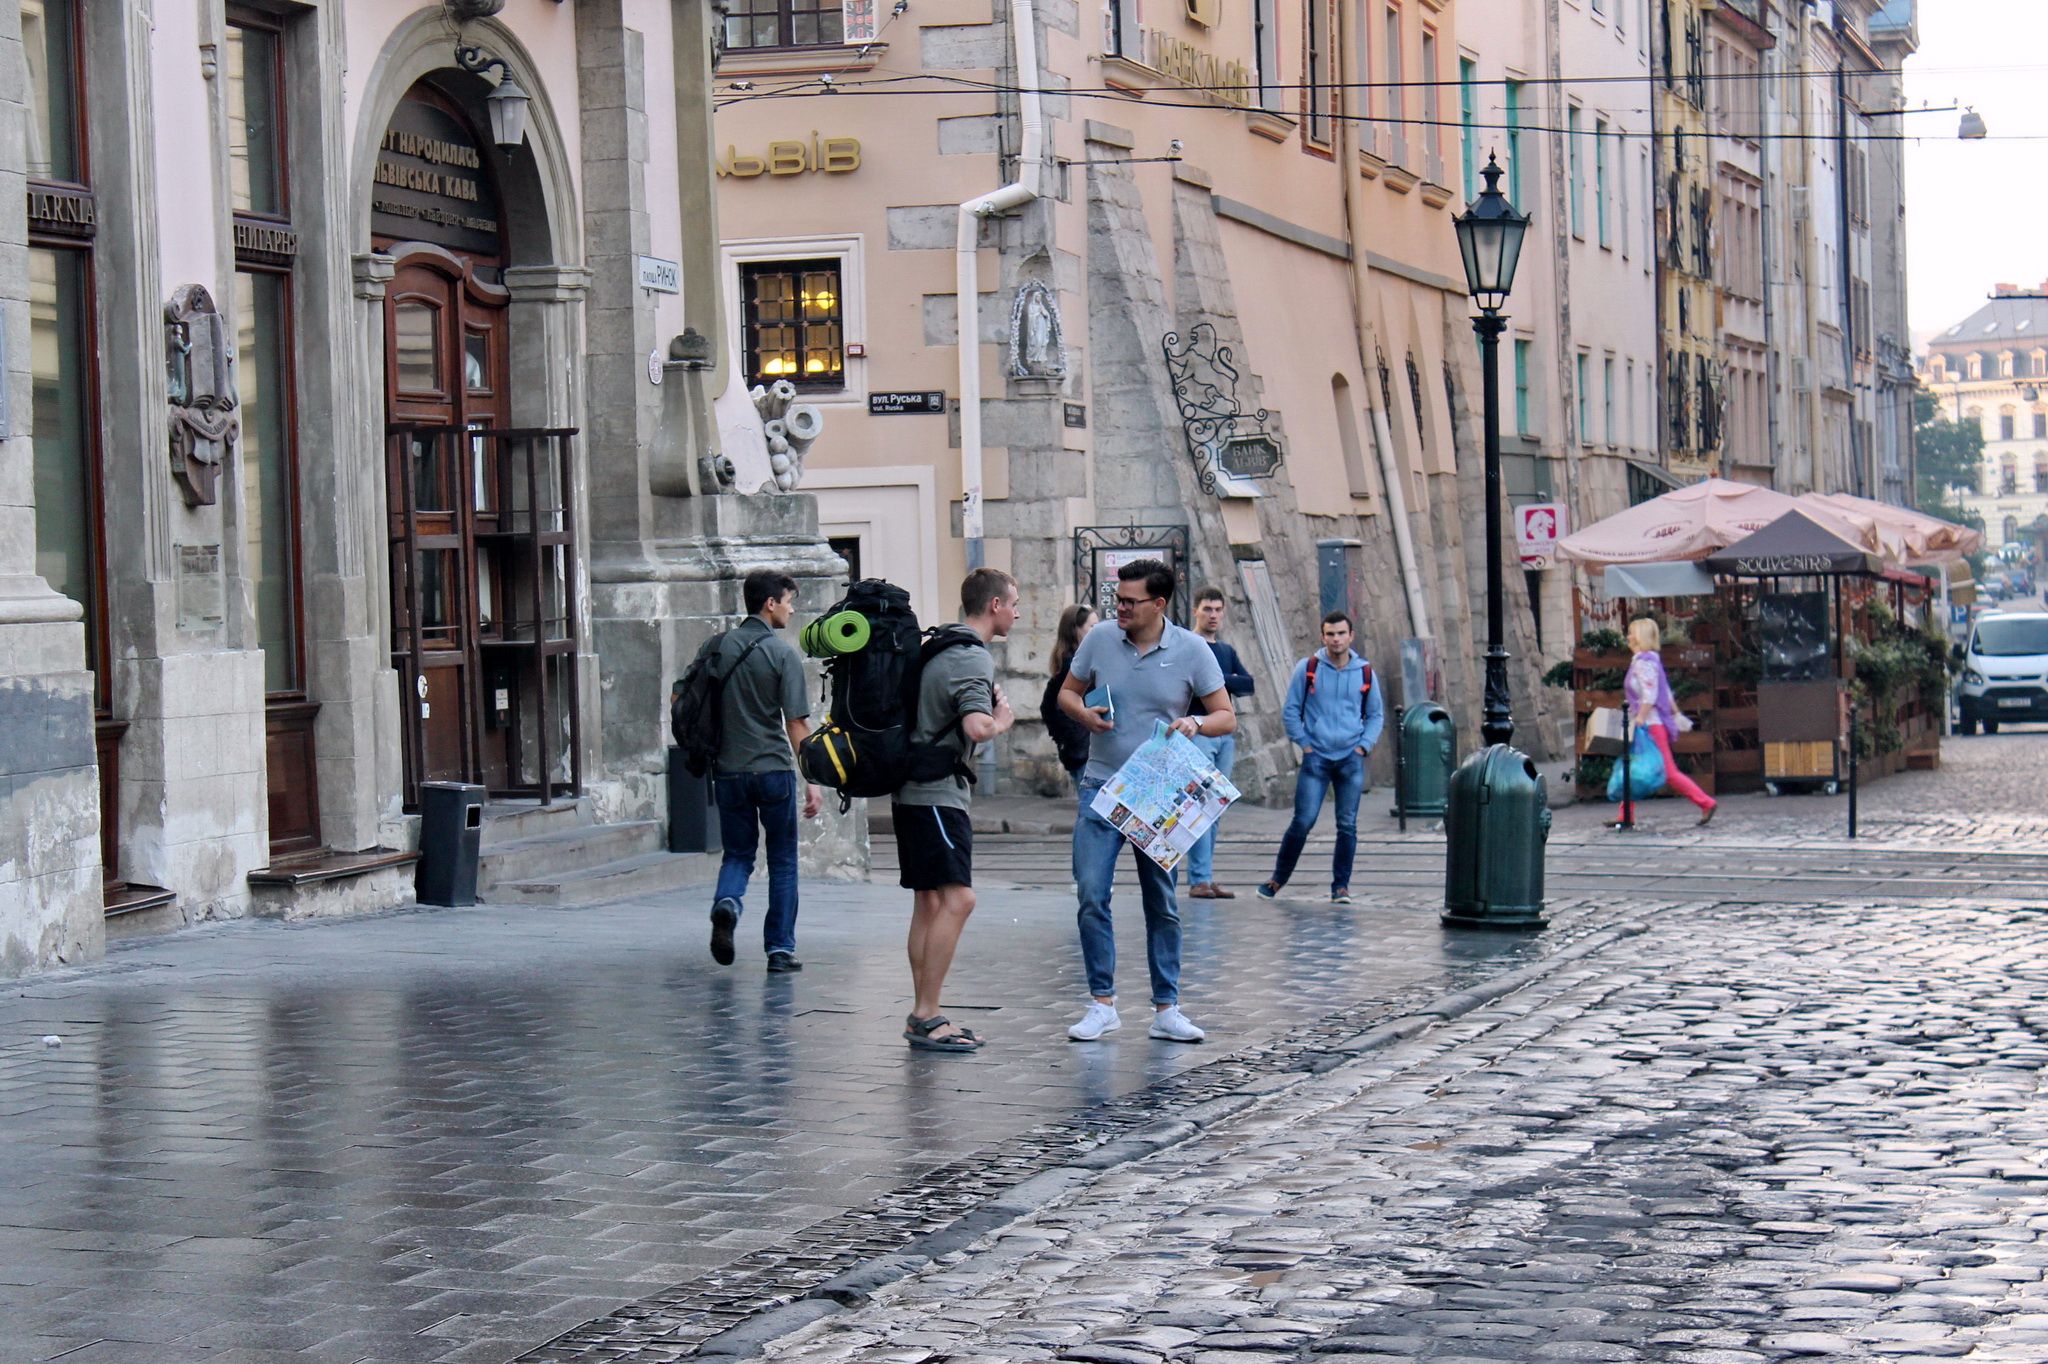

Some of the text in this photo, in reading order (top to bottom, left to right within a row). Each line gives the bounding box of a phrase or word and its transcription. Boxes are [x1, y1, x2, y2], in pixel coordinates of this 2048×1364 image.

[400, 135, 480, 169] НАРОДИЛАСЬ
[373, 160, 478, 201] ЛЬВІВСЬКА КАВА
[233, 225, 300, 256] НИГАРНЯ
[890, 394, 922, 404] Руська
